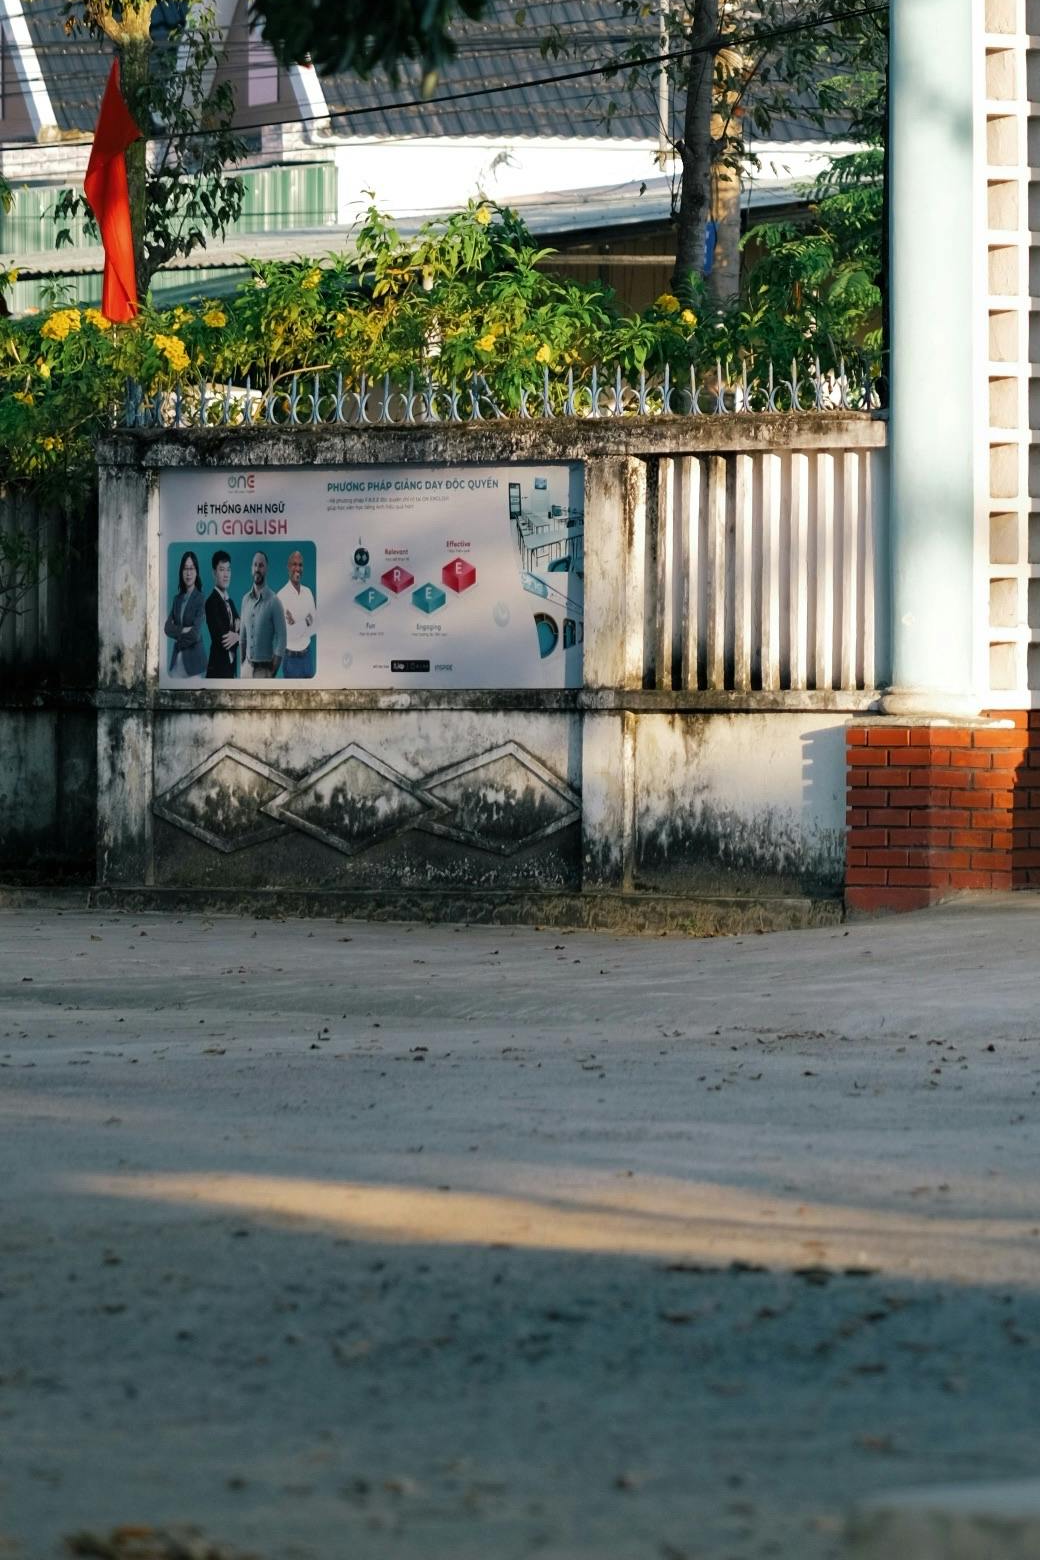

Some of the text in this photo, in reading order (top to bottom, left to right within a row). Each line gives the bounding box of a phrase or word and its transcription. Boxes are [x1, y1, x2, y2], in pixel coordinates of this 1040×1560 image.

[327, 480, 365, 492] PHƯƠNG
[367, 479, 393, 491] PHÁP
[394, 478, 423, 491] GIẢNG
[445, 478, 465, 492] ĐỘC
[197, 500, 286, 517] HỆ THỐNG ANH NGỮ
[222, 518, 288, 536] ENGLISH
[446, 539, 471, 548] Effective
[384, 548, 409, 556] Relevant
[455, 562, 463, 575] E
[393, 569, 401, 582] R
[368, 591, 375, 604] F
[425, 587, 432, 599] E
